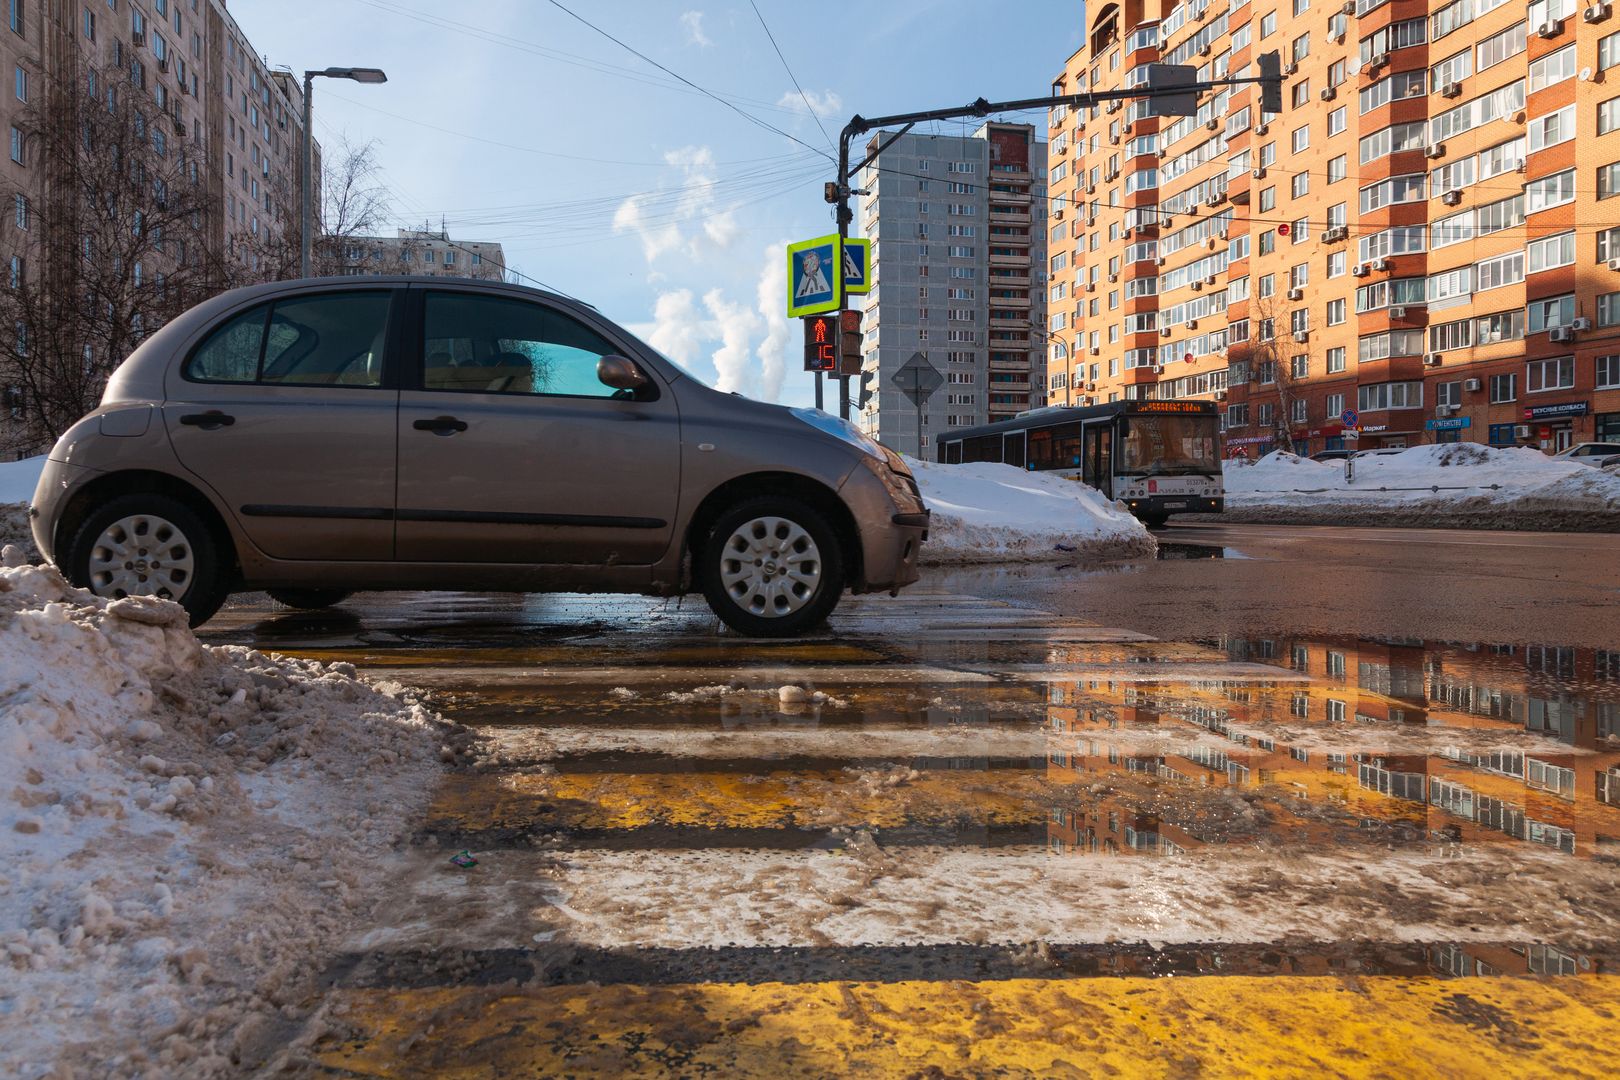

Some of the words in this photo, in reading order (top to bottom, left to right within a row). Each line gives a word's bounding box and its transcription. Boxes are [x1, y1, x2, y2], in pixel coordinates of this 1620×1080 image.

[818, 344, 835, 369] 15
[1532, 406, 1558, 414] ВКУСНЫЕ
[1559, 403, 1586, 411] КОЛБАСЫ
